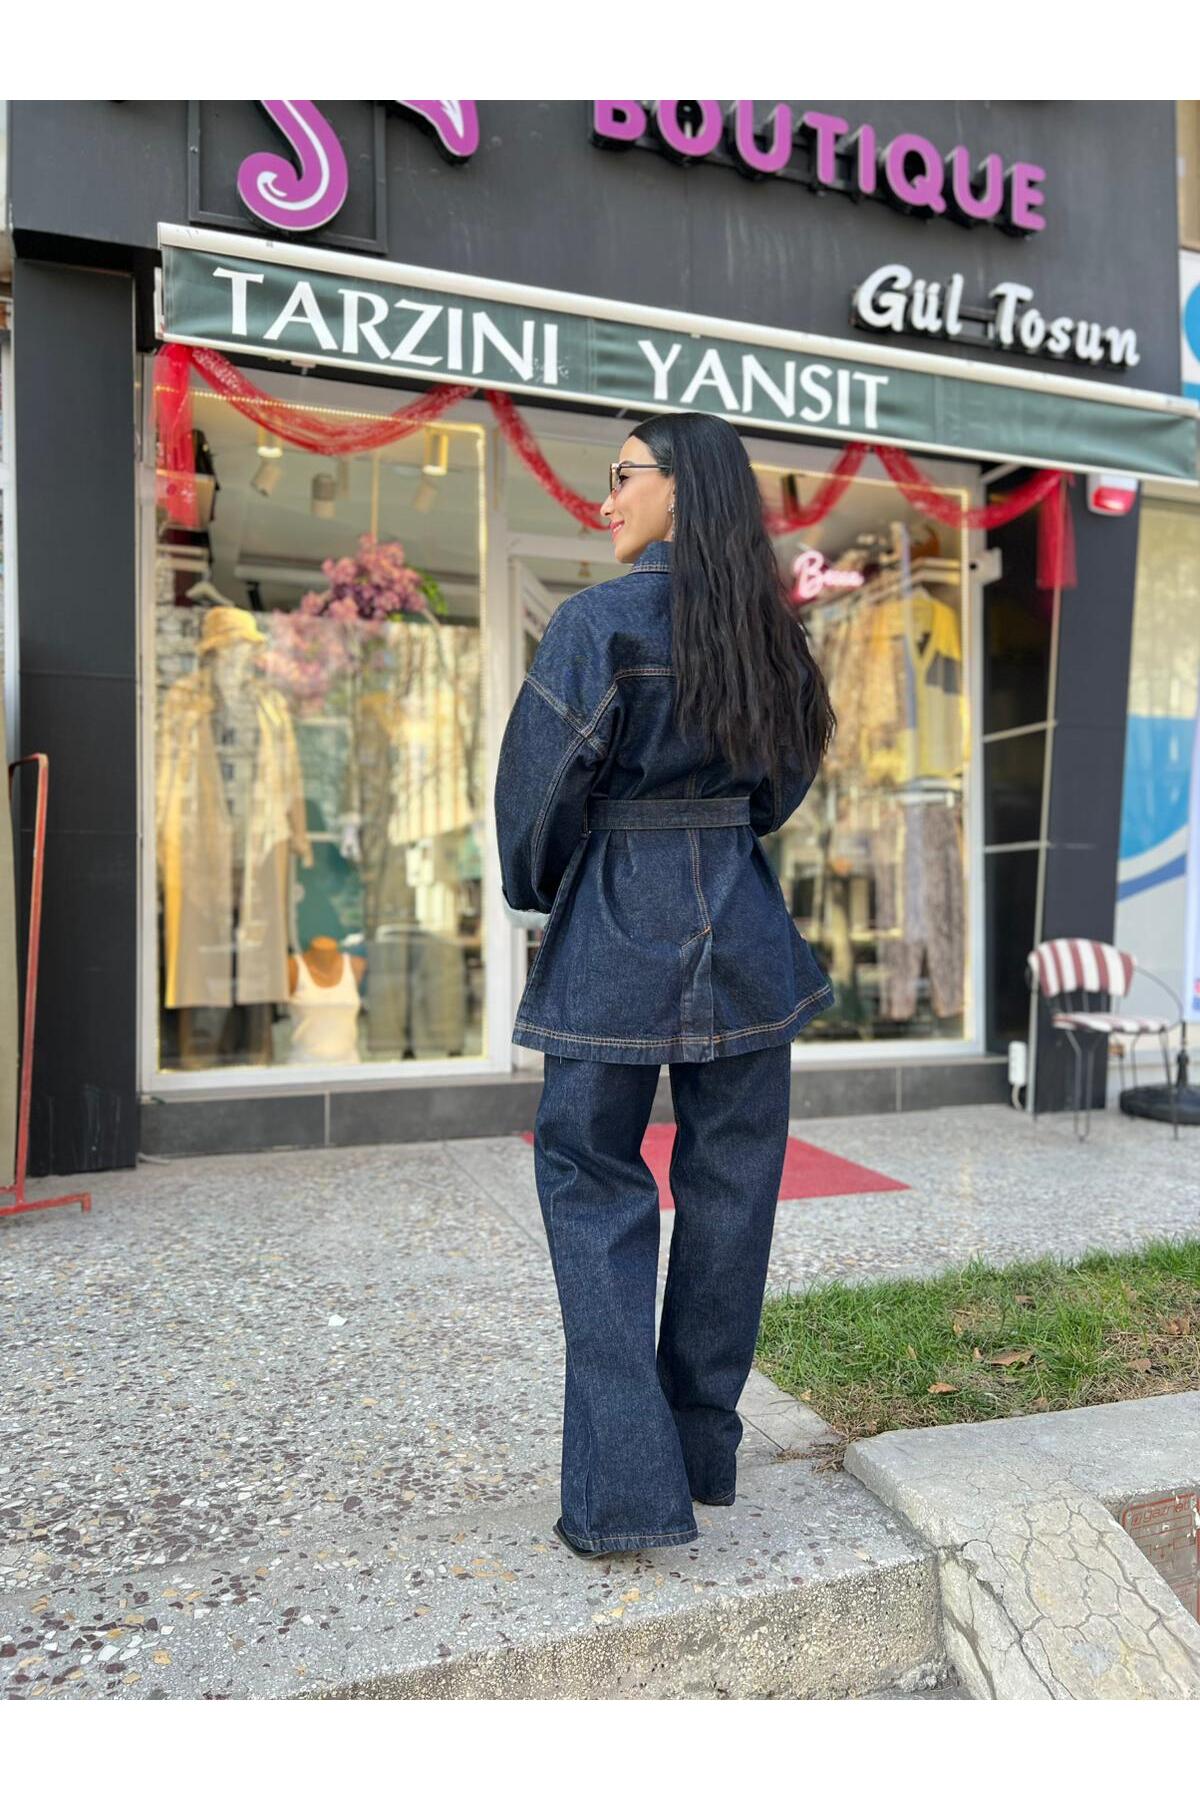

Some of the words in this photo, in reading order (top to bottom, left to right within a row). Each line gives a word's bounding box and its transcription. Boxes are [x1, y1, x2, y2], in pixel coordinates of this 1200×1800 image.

[594, 100, 1047, 231] BOUTIQUE
[213, 267, 560, 385] TARZINI
[638, 340, 889, 429] YANSIT
[855, 264, 963, 335] Gül
[991, 282, 1140, 367] Tosun
